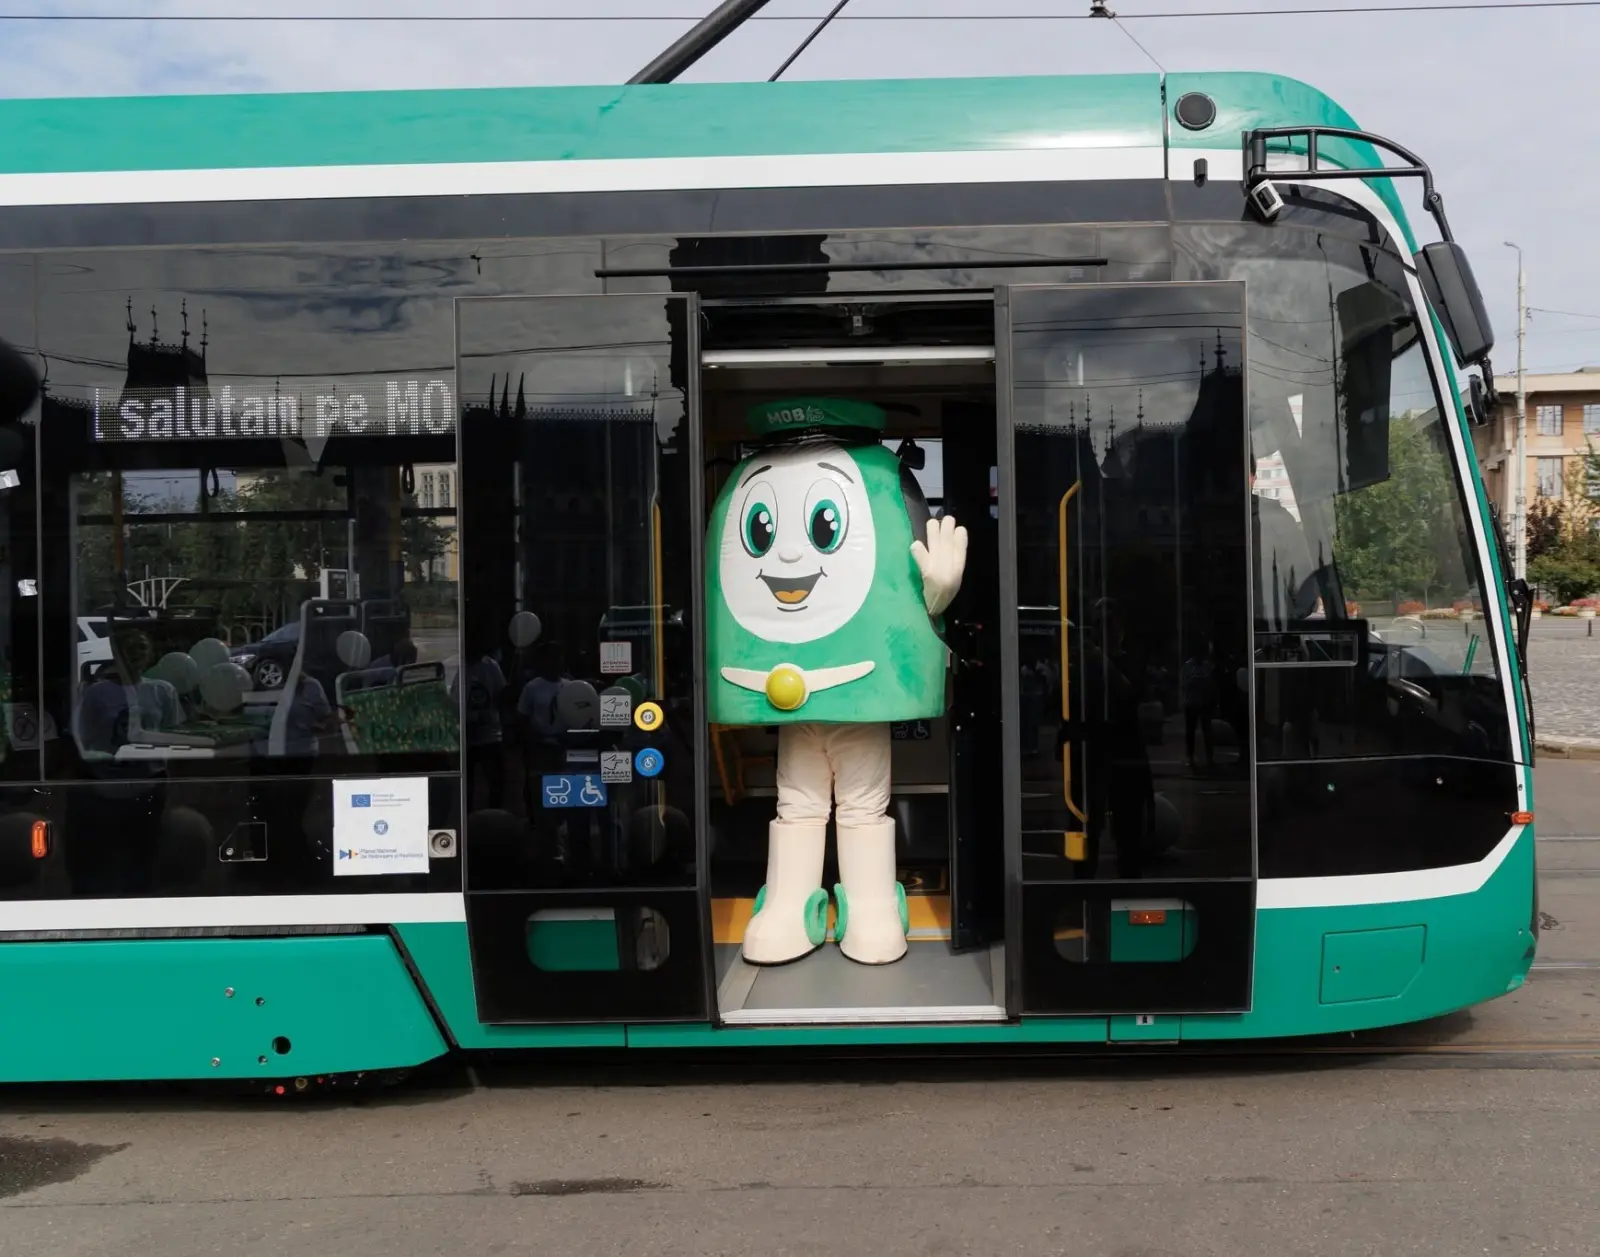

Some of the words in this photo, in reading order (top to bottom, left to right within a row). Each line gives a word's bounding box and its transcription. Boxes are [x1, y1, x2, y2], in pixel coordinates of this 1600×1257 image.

[120, 384, 297, 438] salutam
[316, 394, 368, 437] pe
[387, 380, 452, 435] MO
